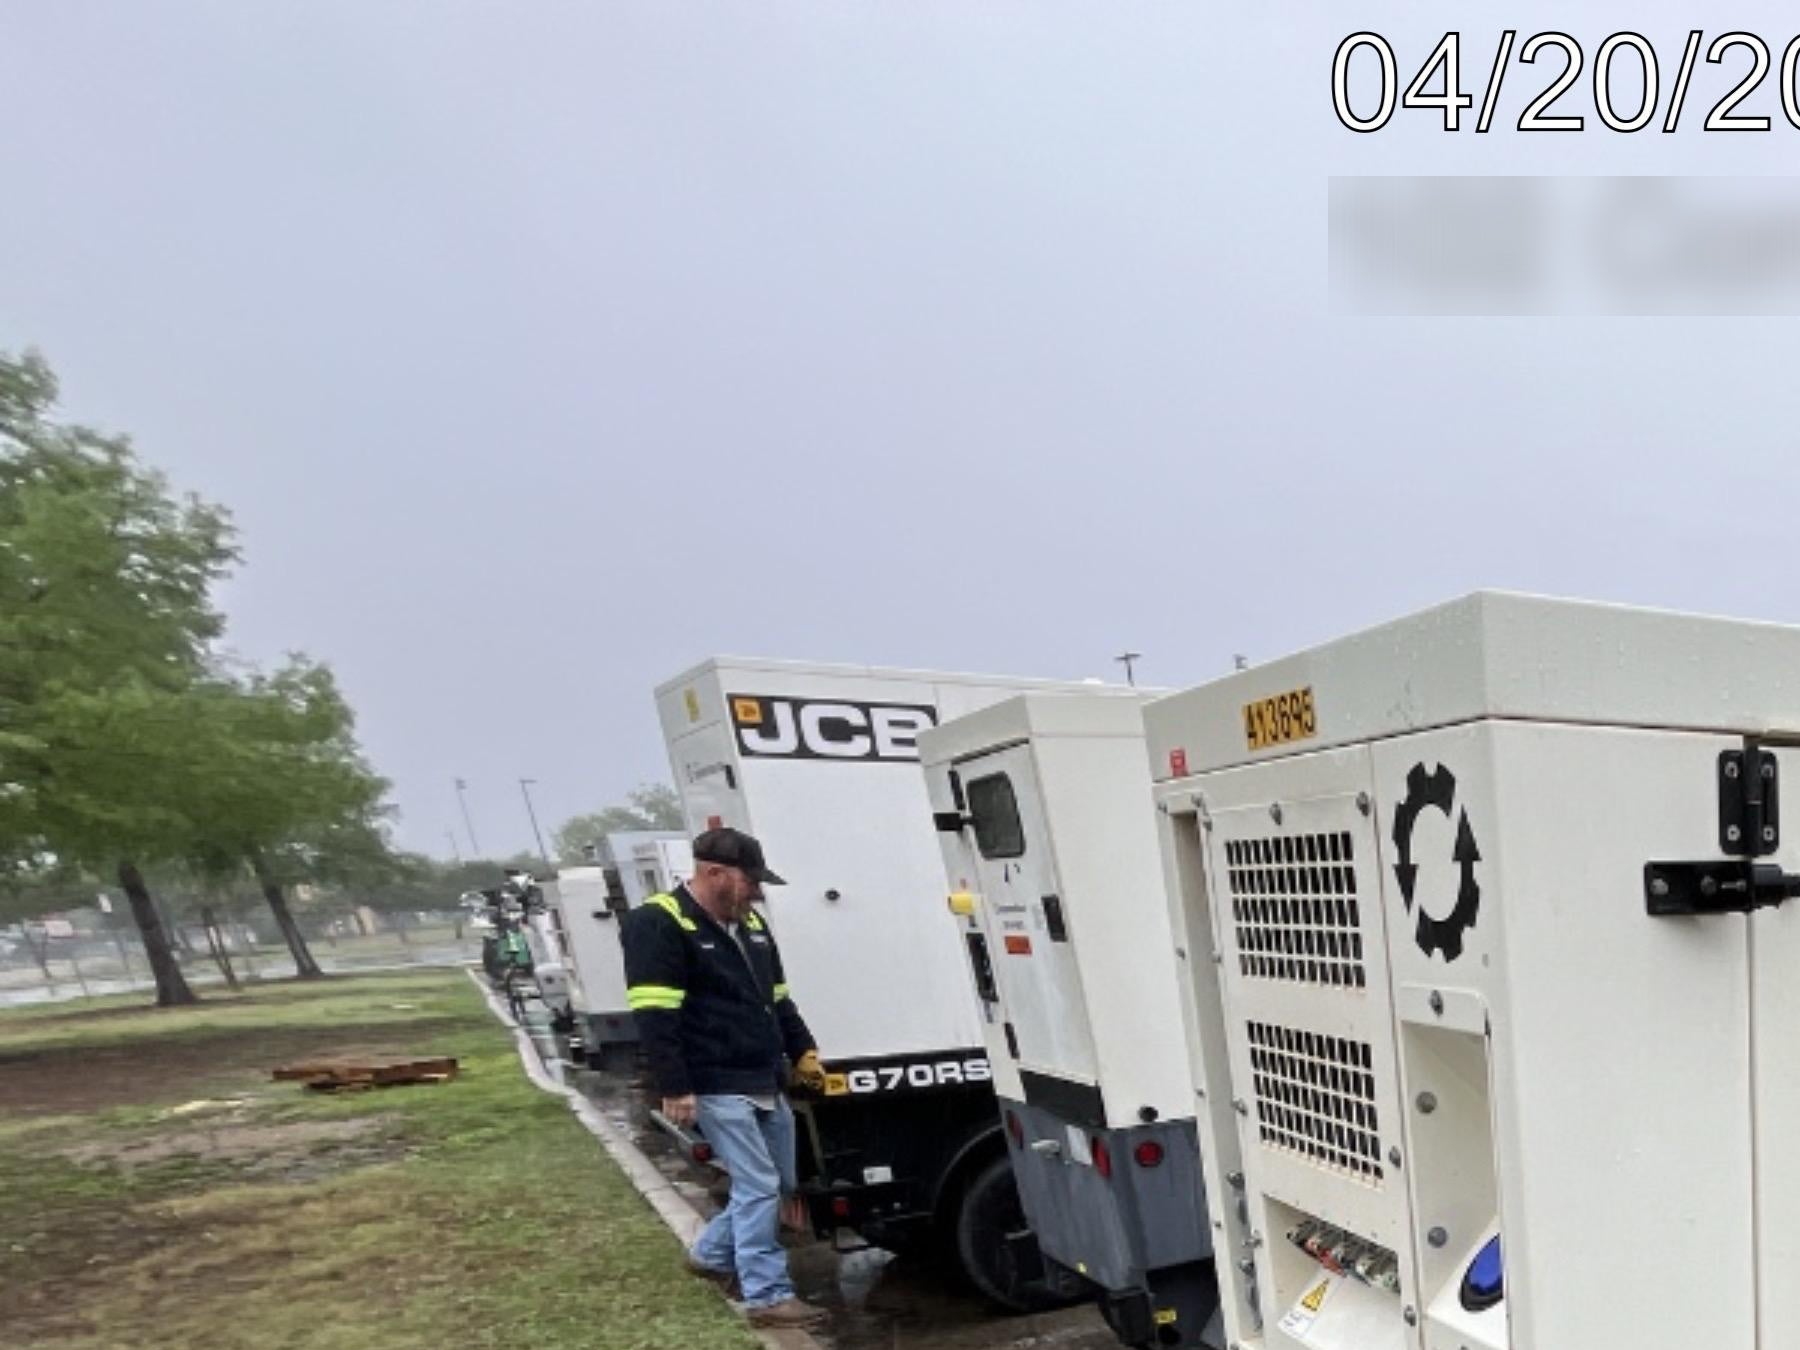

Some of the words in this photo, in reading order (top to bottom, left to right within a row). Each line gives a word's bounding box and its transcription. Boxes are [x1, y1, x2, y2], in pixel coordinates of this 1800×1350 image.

[740, 700, 935, 758] JCB
[1246, 685, 1316, 748] 413695
[849, 1058, 992, 1093] G70RS
